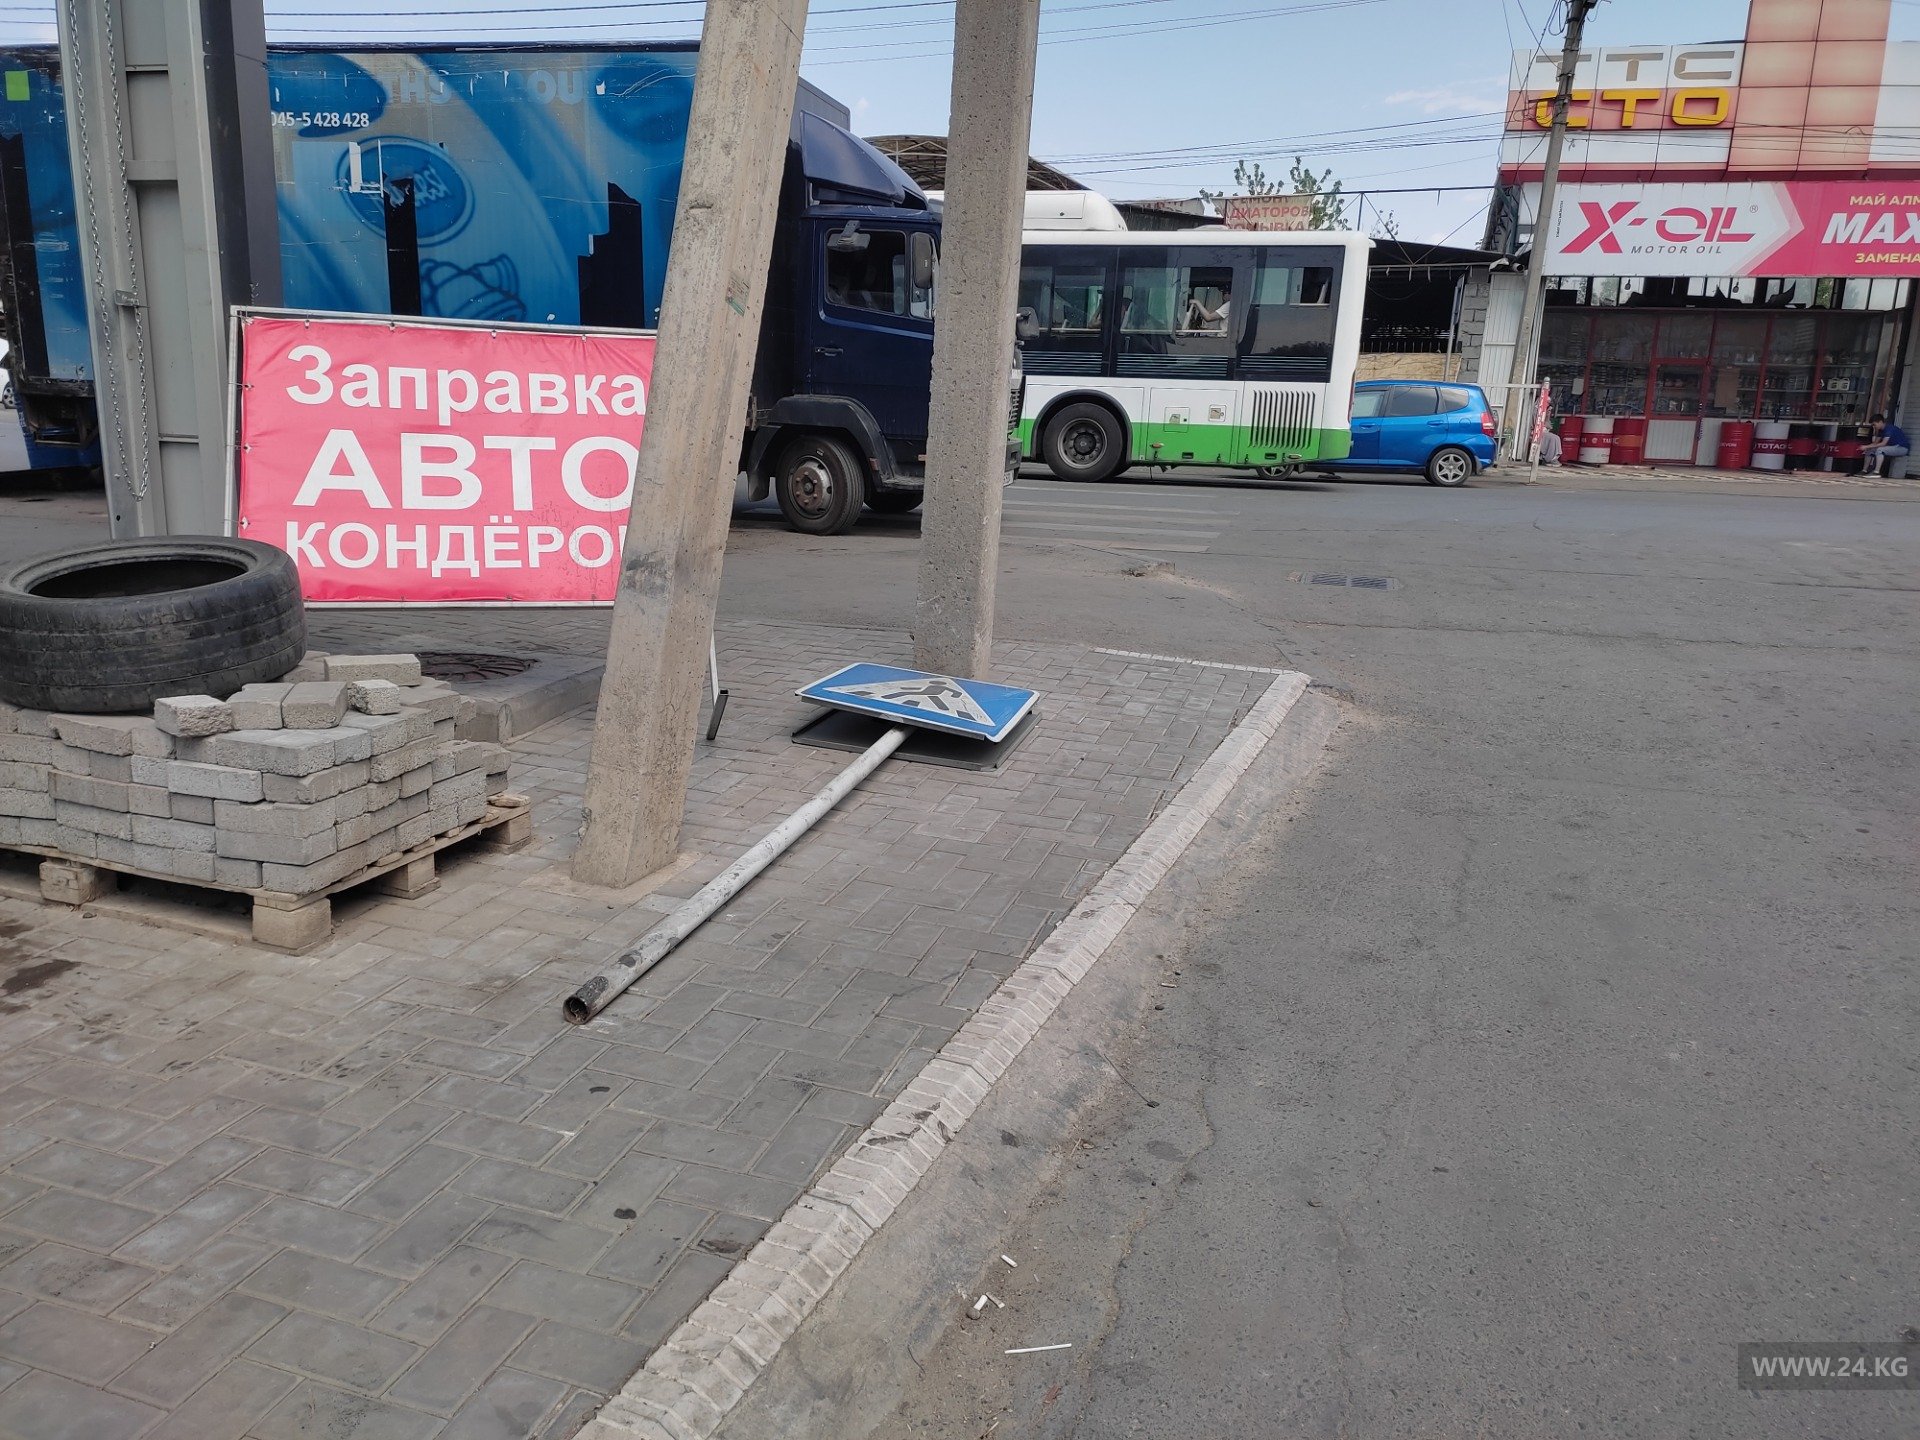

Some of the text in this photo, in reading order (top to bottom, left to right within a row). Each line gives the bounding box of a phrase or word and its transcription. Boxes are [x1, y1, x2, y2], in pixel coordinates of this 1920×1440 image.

[314, 112, 340, 127] 428
[343, 112, 370, 128] 428
[1536, 88, 1730, 128] СТО
[1849, 193, 1886, 206] МАЙ
[1559, 201, 1757, 254] X-OIL
[1630, 245, 1722, 254] MOTOR OIL
[1854, 253, 1920, 263] ЗАМЕНА
[286, 345, 647, 427] Заправка
[291, 428, 640, 512] АВТО
